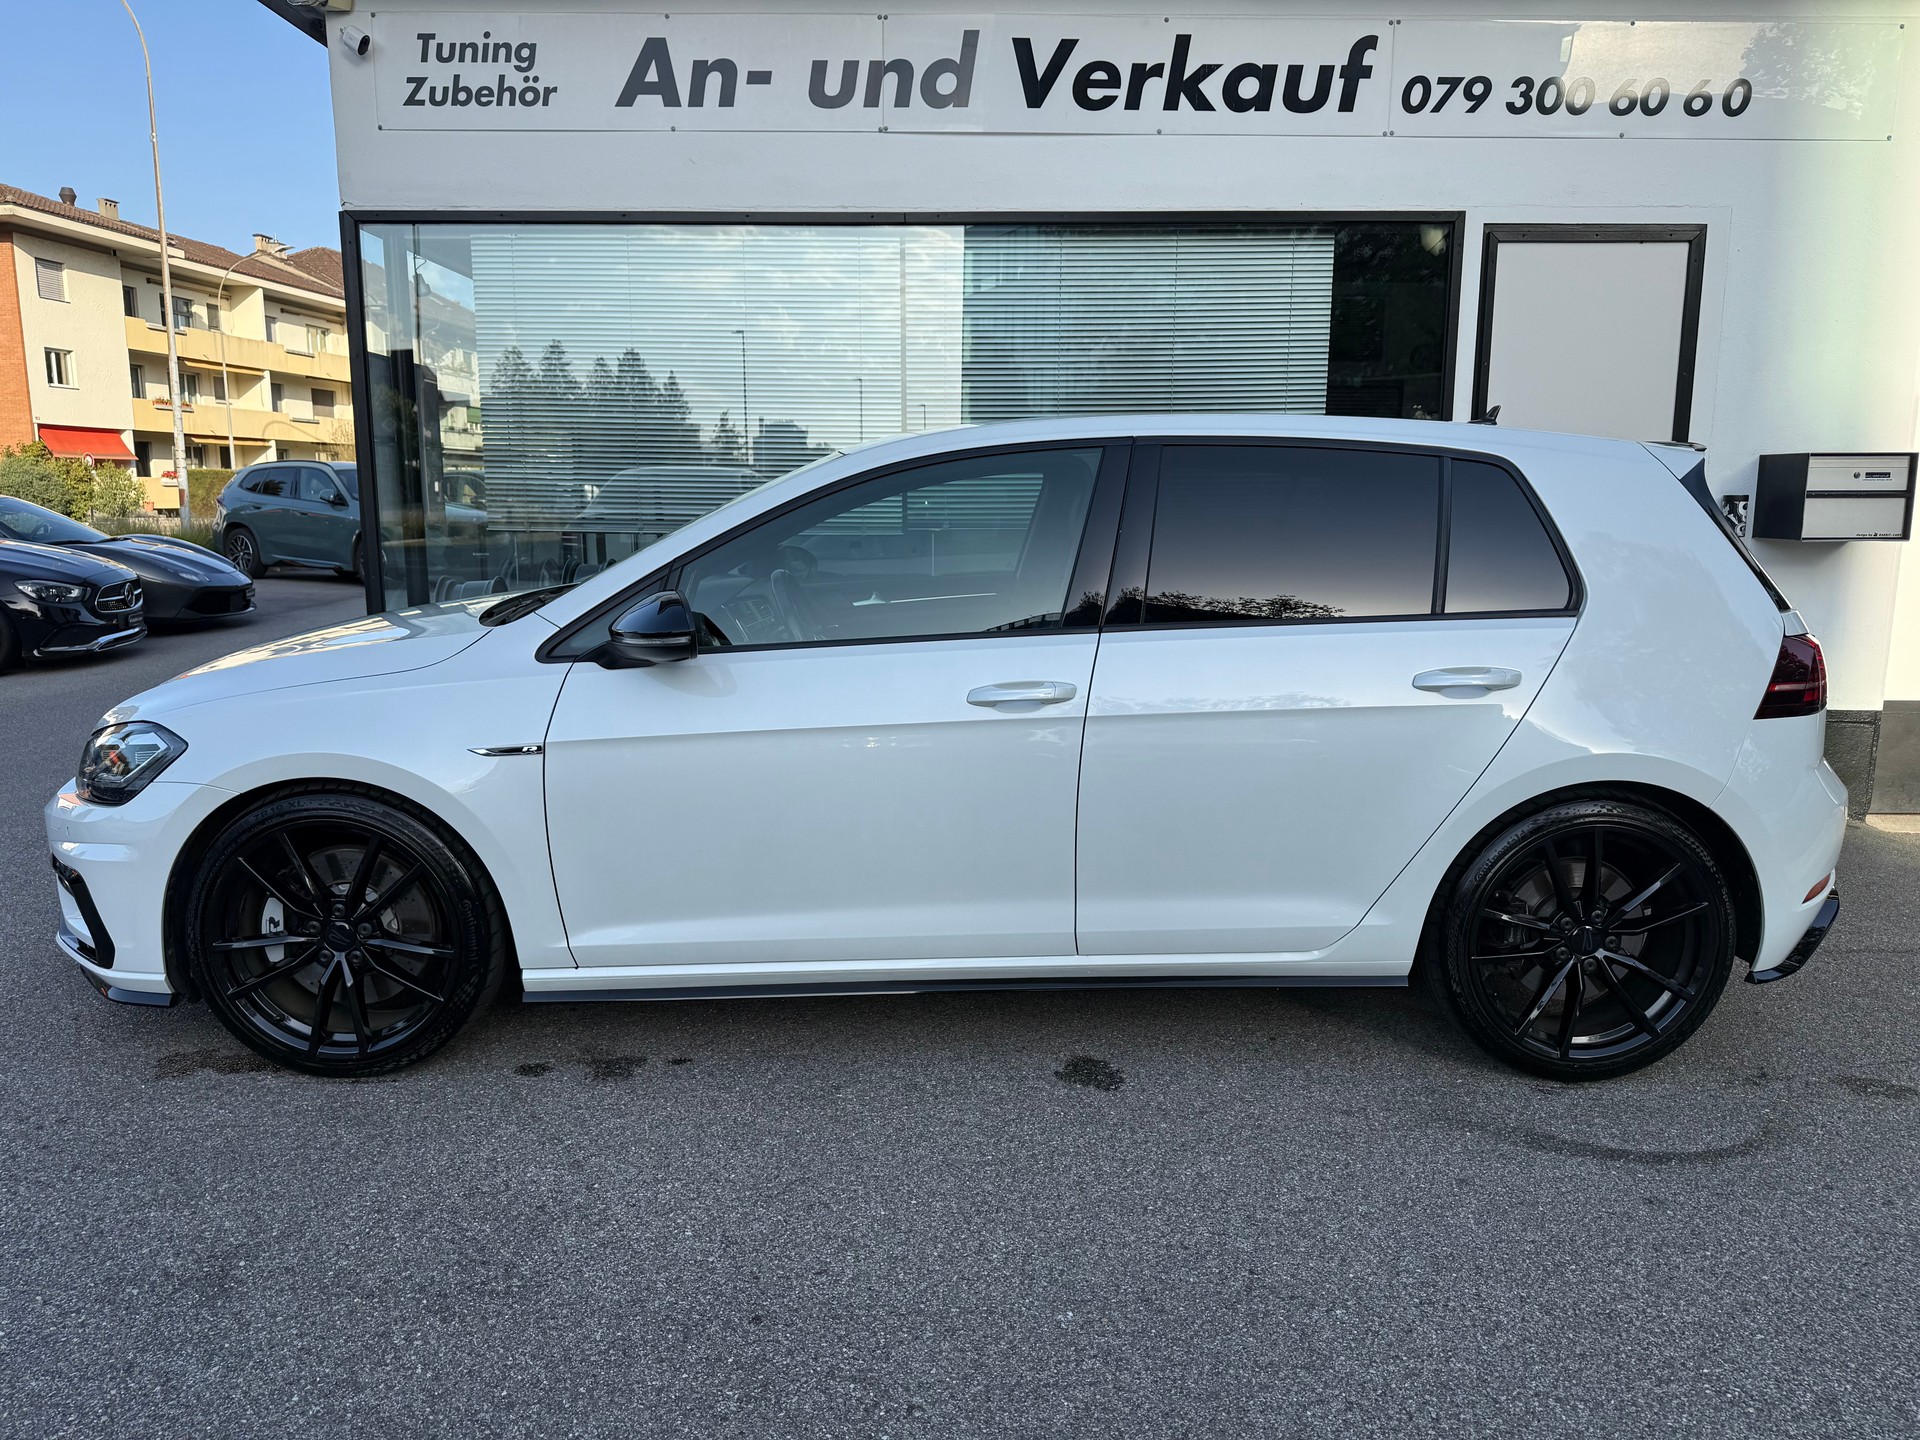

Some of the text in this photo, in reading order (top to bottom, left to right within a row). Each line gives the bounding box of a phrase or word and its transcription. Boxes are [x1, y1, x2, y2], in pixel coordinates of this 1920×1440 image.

[417, 31, 537, 73] Tuning
[615, 29, 1379, 114] An- und Verkauf
[402, 73, 558, 108] Zubehör
[1401, 75, 1493, 115] 079
[1505, 75, 1596, 116] 300
[1608, 77, 1671, 117] 60
[521, 746, 538, 755] R
